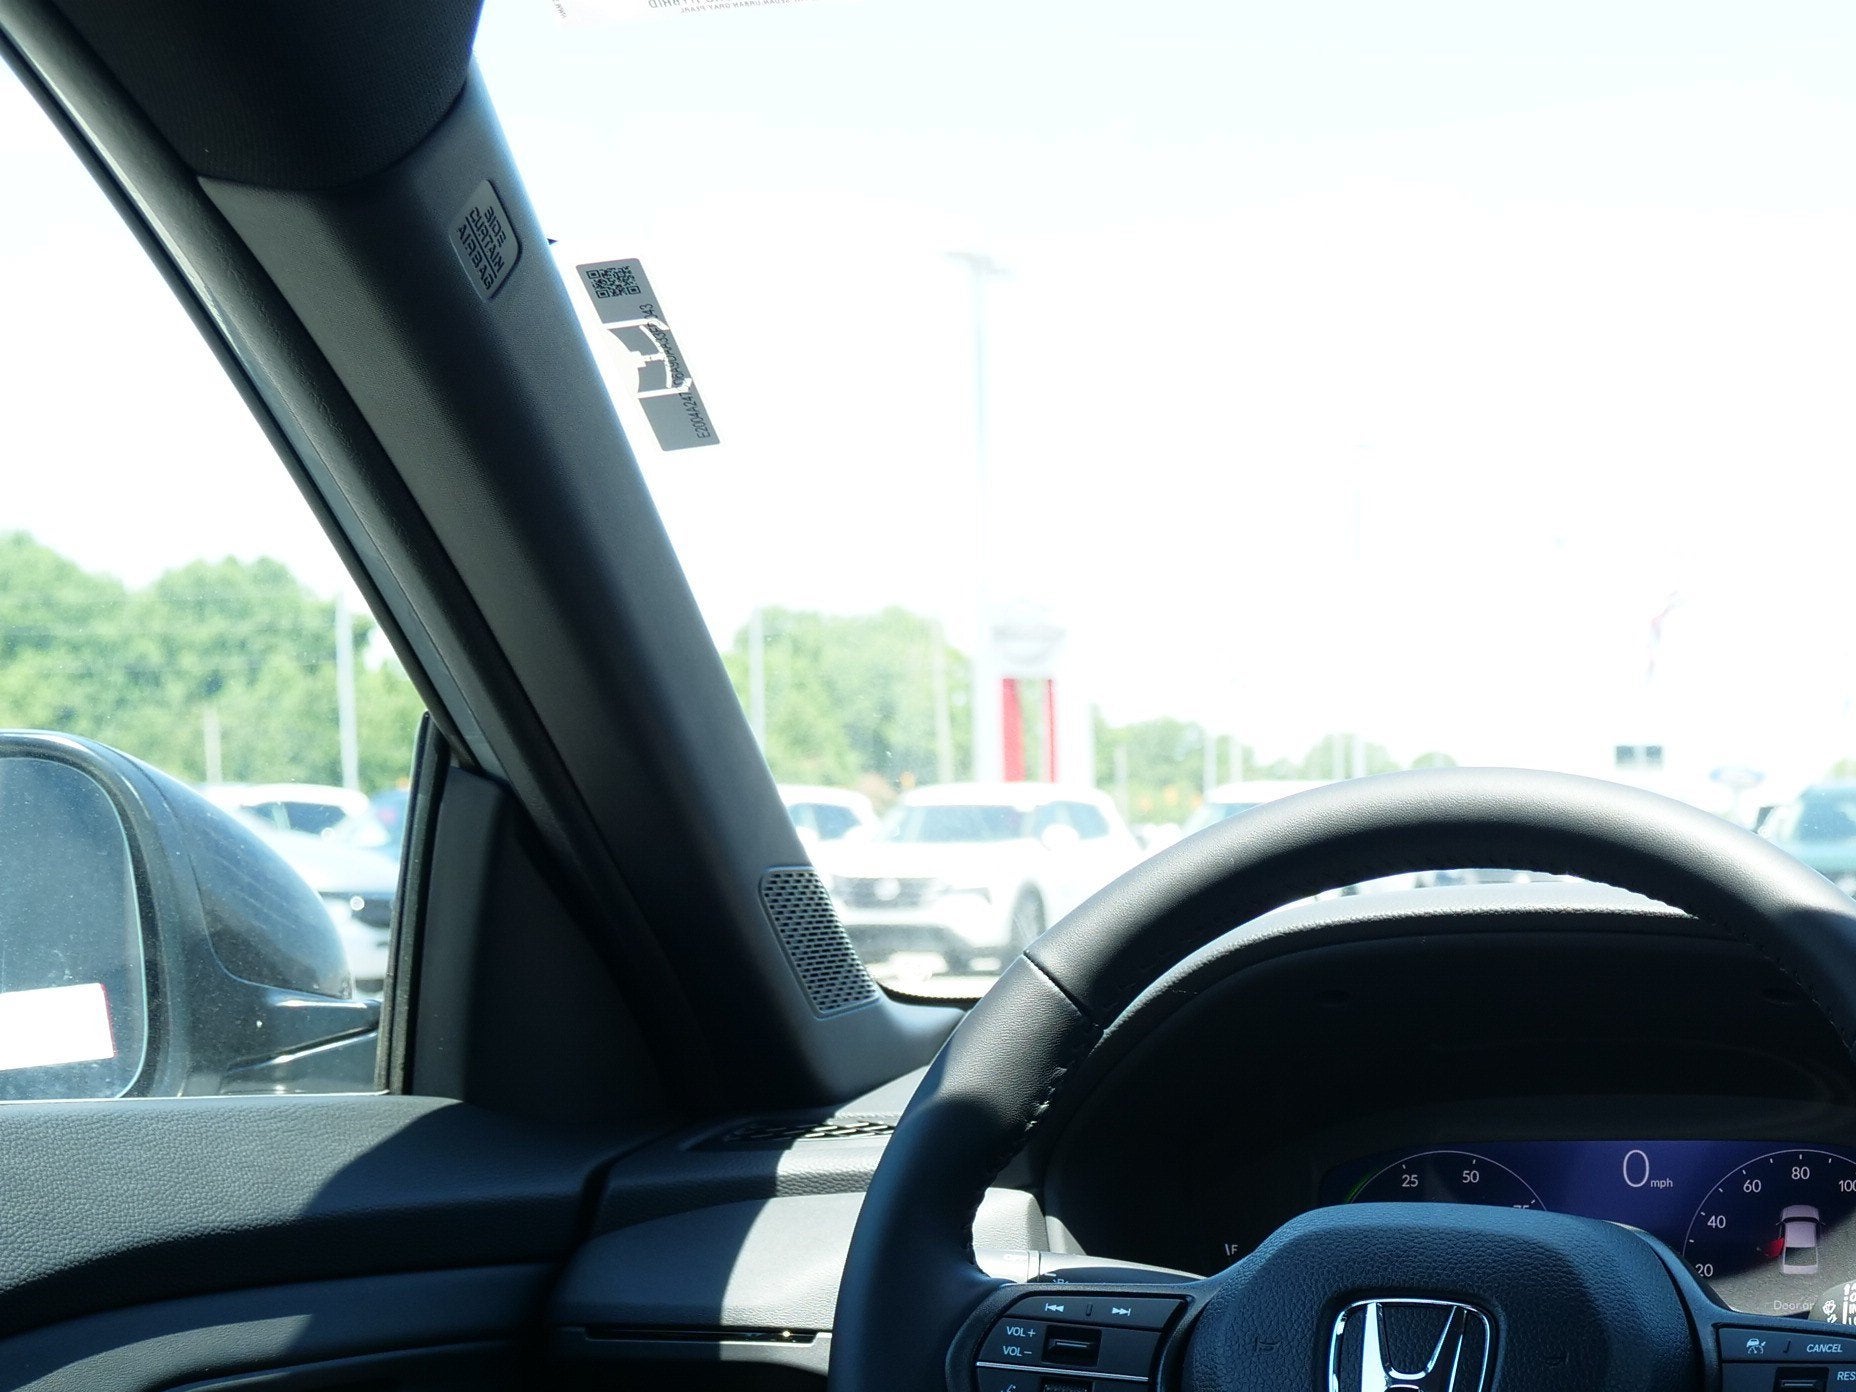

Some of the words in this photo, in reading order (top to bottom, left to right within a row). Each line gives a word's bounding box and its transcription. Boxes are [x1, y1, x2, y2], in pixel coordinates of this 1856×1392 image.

[484, 206, 507, 248] SIDE
[470, 206, 505, 272] CURTAIN
[456, 224, 495, 290] AIRBAG
[1462, 1170, 1480, 1183] 50
[1622, 1149, 1650, 1187] 0
[1650, 1177, 1674, 1190] mph
[1791, 1166, 1811, 1180] 80
[1402, 1174, 1419, 1187] 25
[1743, 1179, 1762, 1193] 60
[1707, 1215, 1726, 1229] 40
[1694, 1264, 1714, 1278] 20
[1773, 1300, 1799, 1310] Door
[1806, 1343, 1843, 1353] CANCEL
